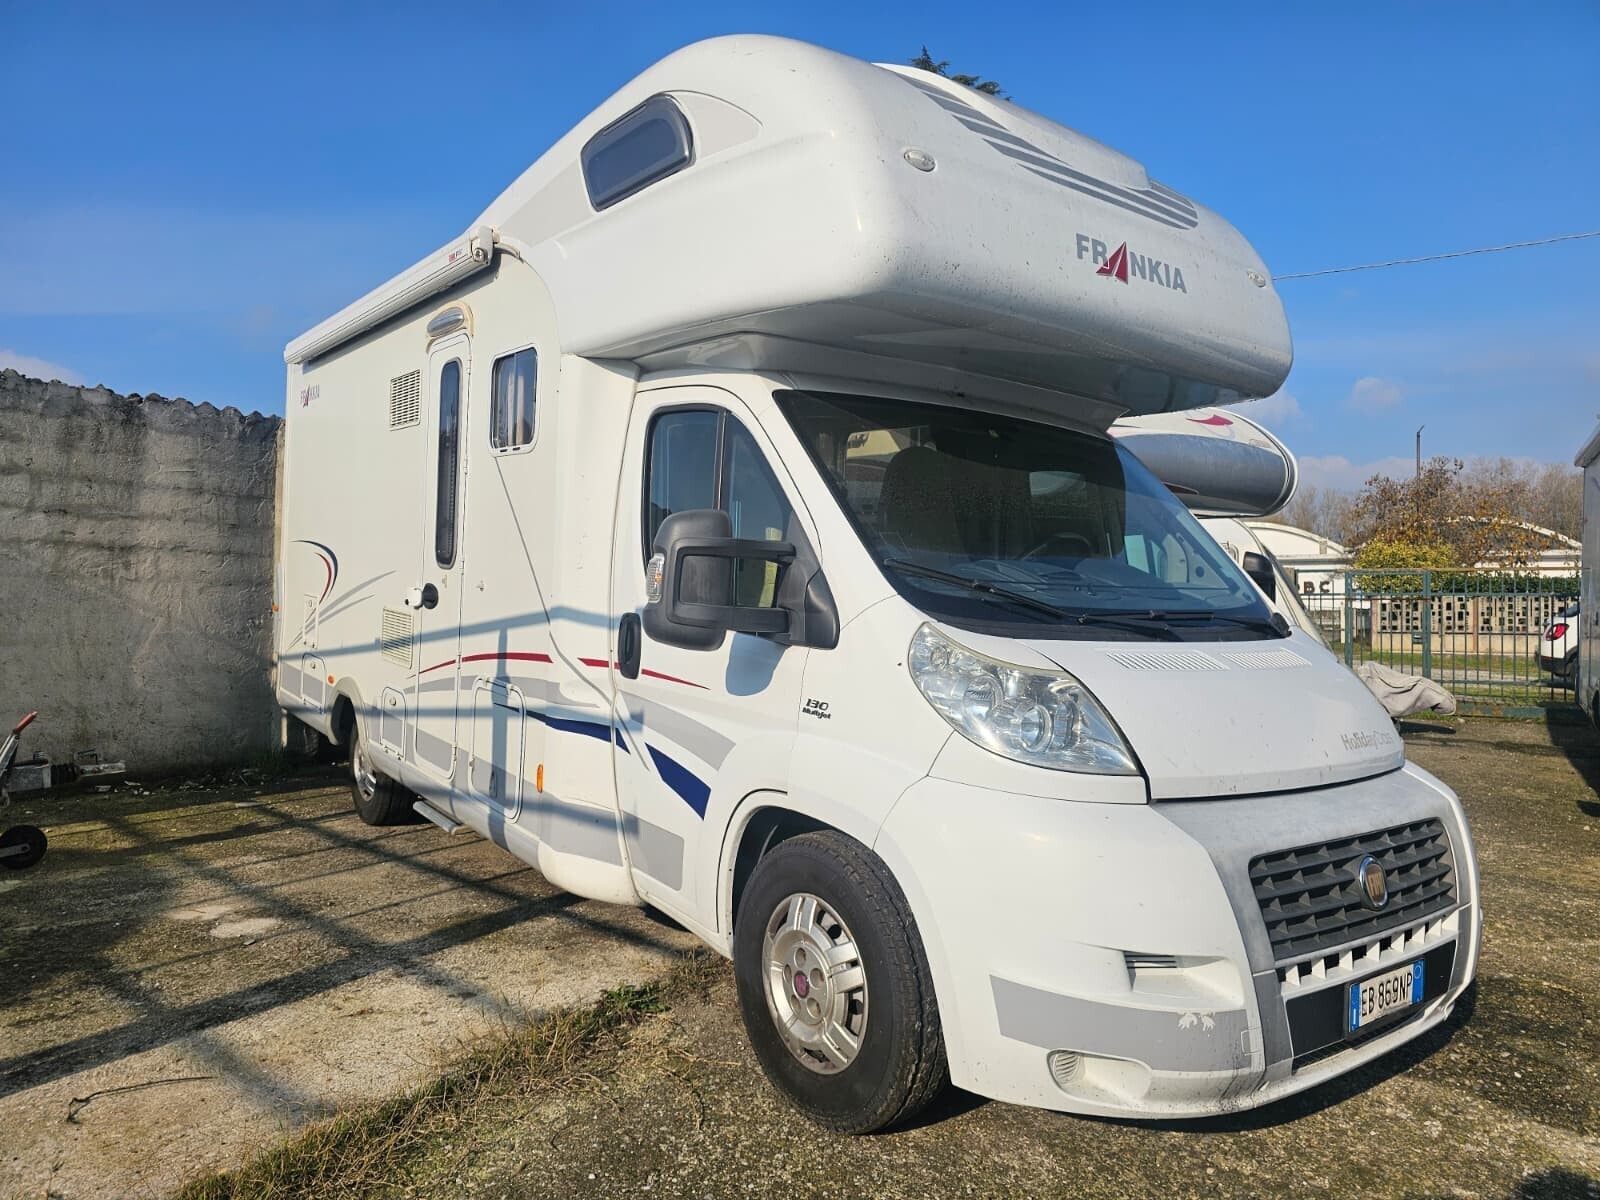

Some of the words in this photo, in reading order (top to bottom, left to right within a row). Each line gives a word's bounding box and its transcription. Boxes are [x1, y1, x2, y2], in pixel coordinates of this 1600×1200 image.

[1076, 233, 1187, 294] FRANKIA
[806, 698, 829, 711] 130
[1361, 986, 1375, 1017] EB
[1378, 972, 1413, 1009] 869NP
